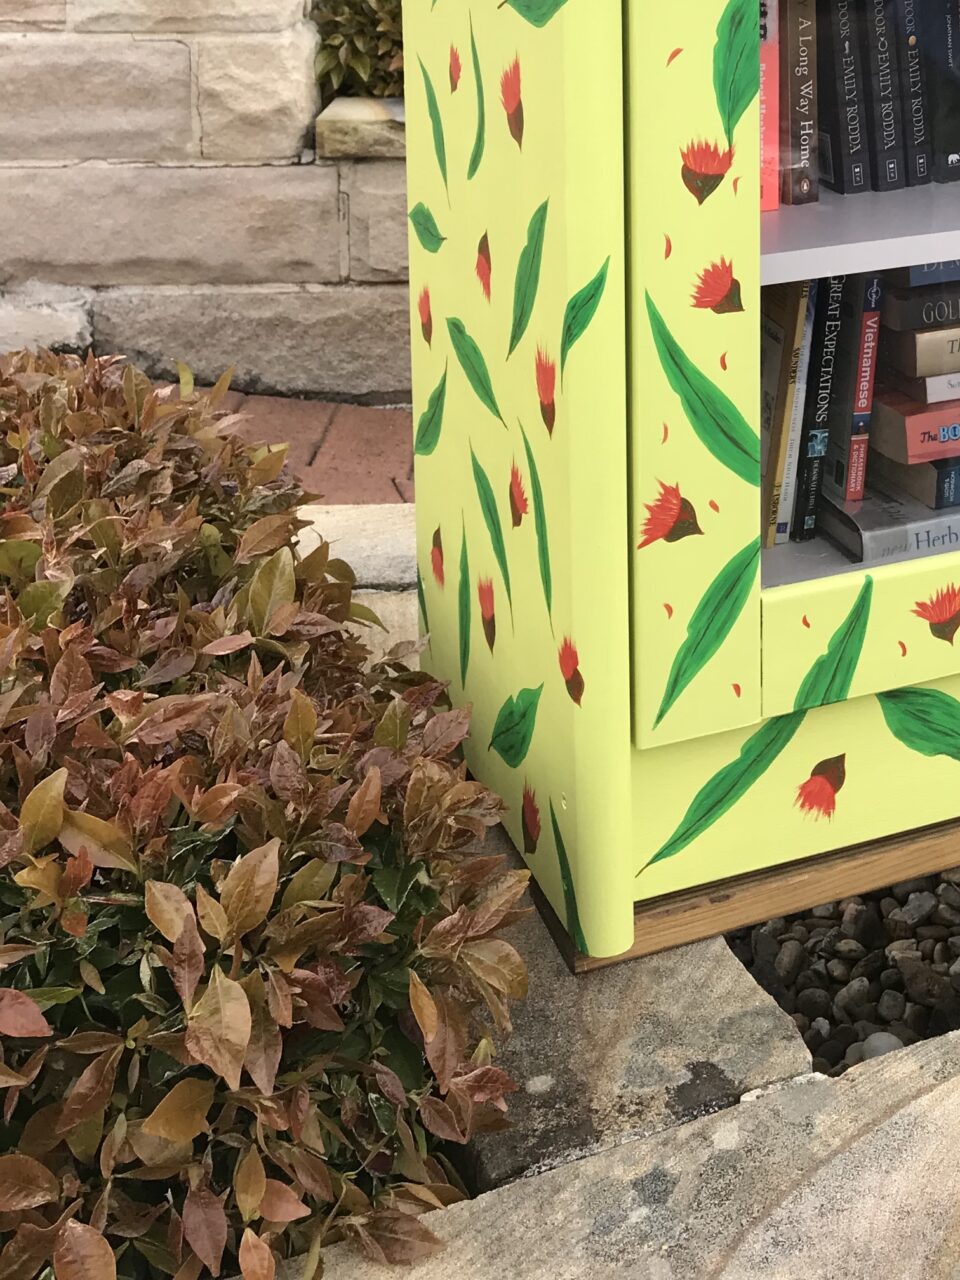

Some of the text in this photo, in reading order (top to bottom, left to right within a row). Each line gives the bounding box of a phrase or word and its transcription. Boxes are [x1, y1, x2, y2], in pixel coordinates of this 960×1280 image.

[838, 1, 851, 39] DOOR
[873, 0, 887, 36] DOOR
[904, 0, 916, 34] DOOR
[795, 18, 814, 168] A Long Way Home
[843, 55, 861, 155] EMILY RODDA
[877, 53, 896, 151] EMILY RODDA
[907, 48, 926, 145] EMILY RODDA
[815, 275, 846, 423] GREAT EXPECTATIONS
[856, 317, 878, 408] Vietnamese
[920, 430, 939, 444] The
[848, 452, 858, 493] DICTIONARY
[855, 443, 865, 492] PHRASEBOOK
[914, 525, 959, 551] Herb
